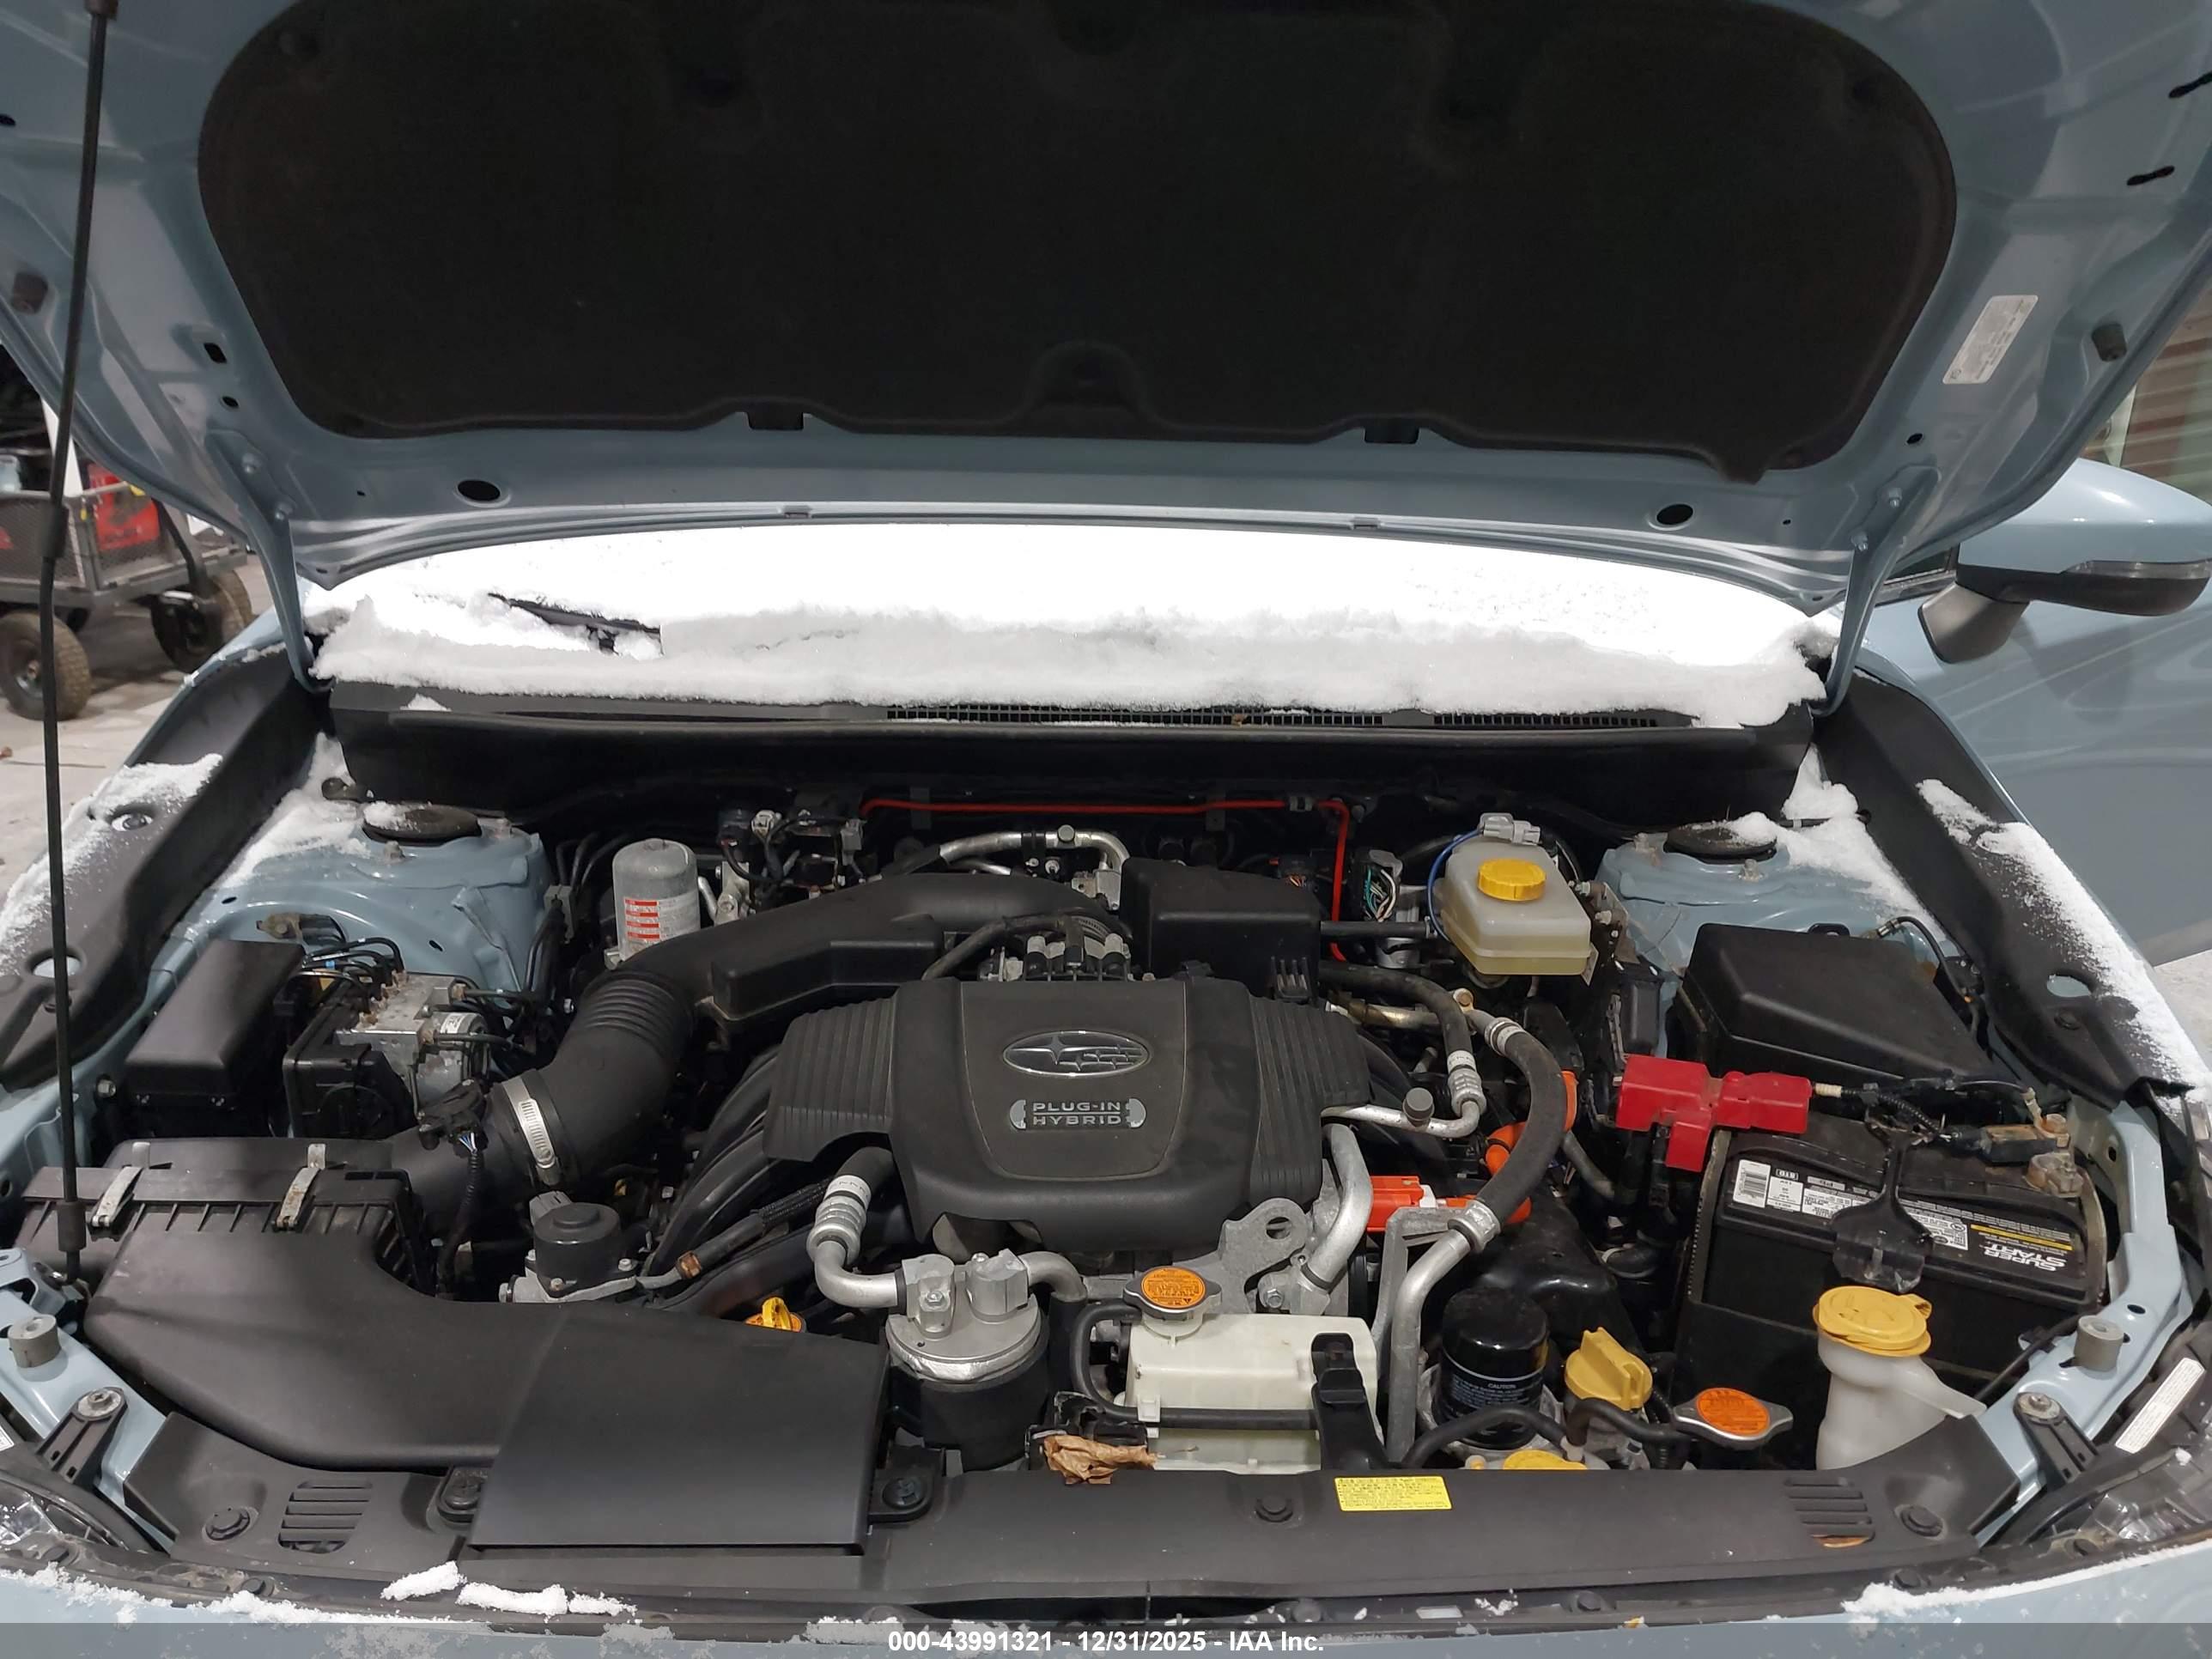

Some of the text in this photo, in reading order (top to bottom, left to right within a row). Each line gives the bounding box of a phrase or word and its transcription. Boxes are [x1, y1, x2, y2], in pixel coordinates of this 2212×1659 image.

[1032, 1102, 1121, 1112] PLUG-IN
[1032, 1115, 1121, 1125] HYBRID
[1984, 1243, 2067, 1267] START
[1984, 1249, 2057, 1272] SUPER
